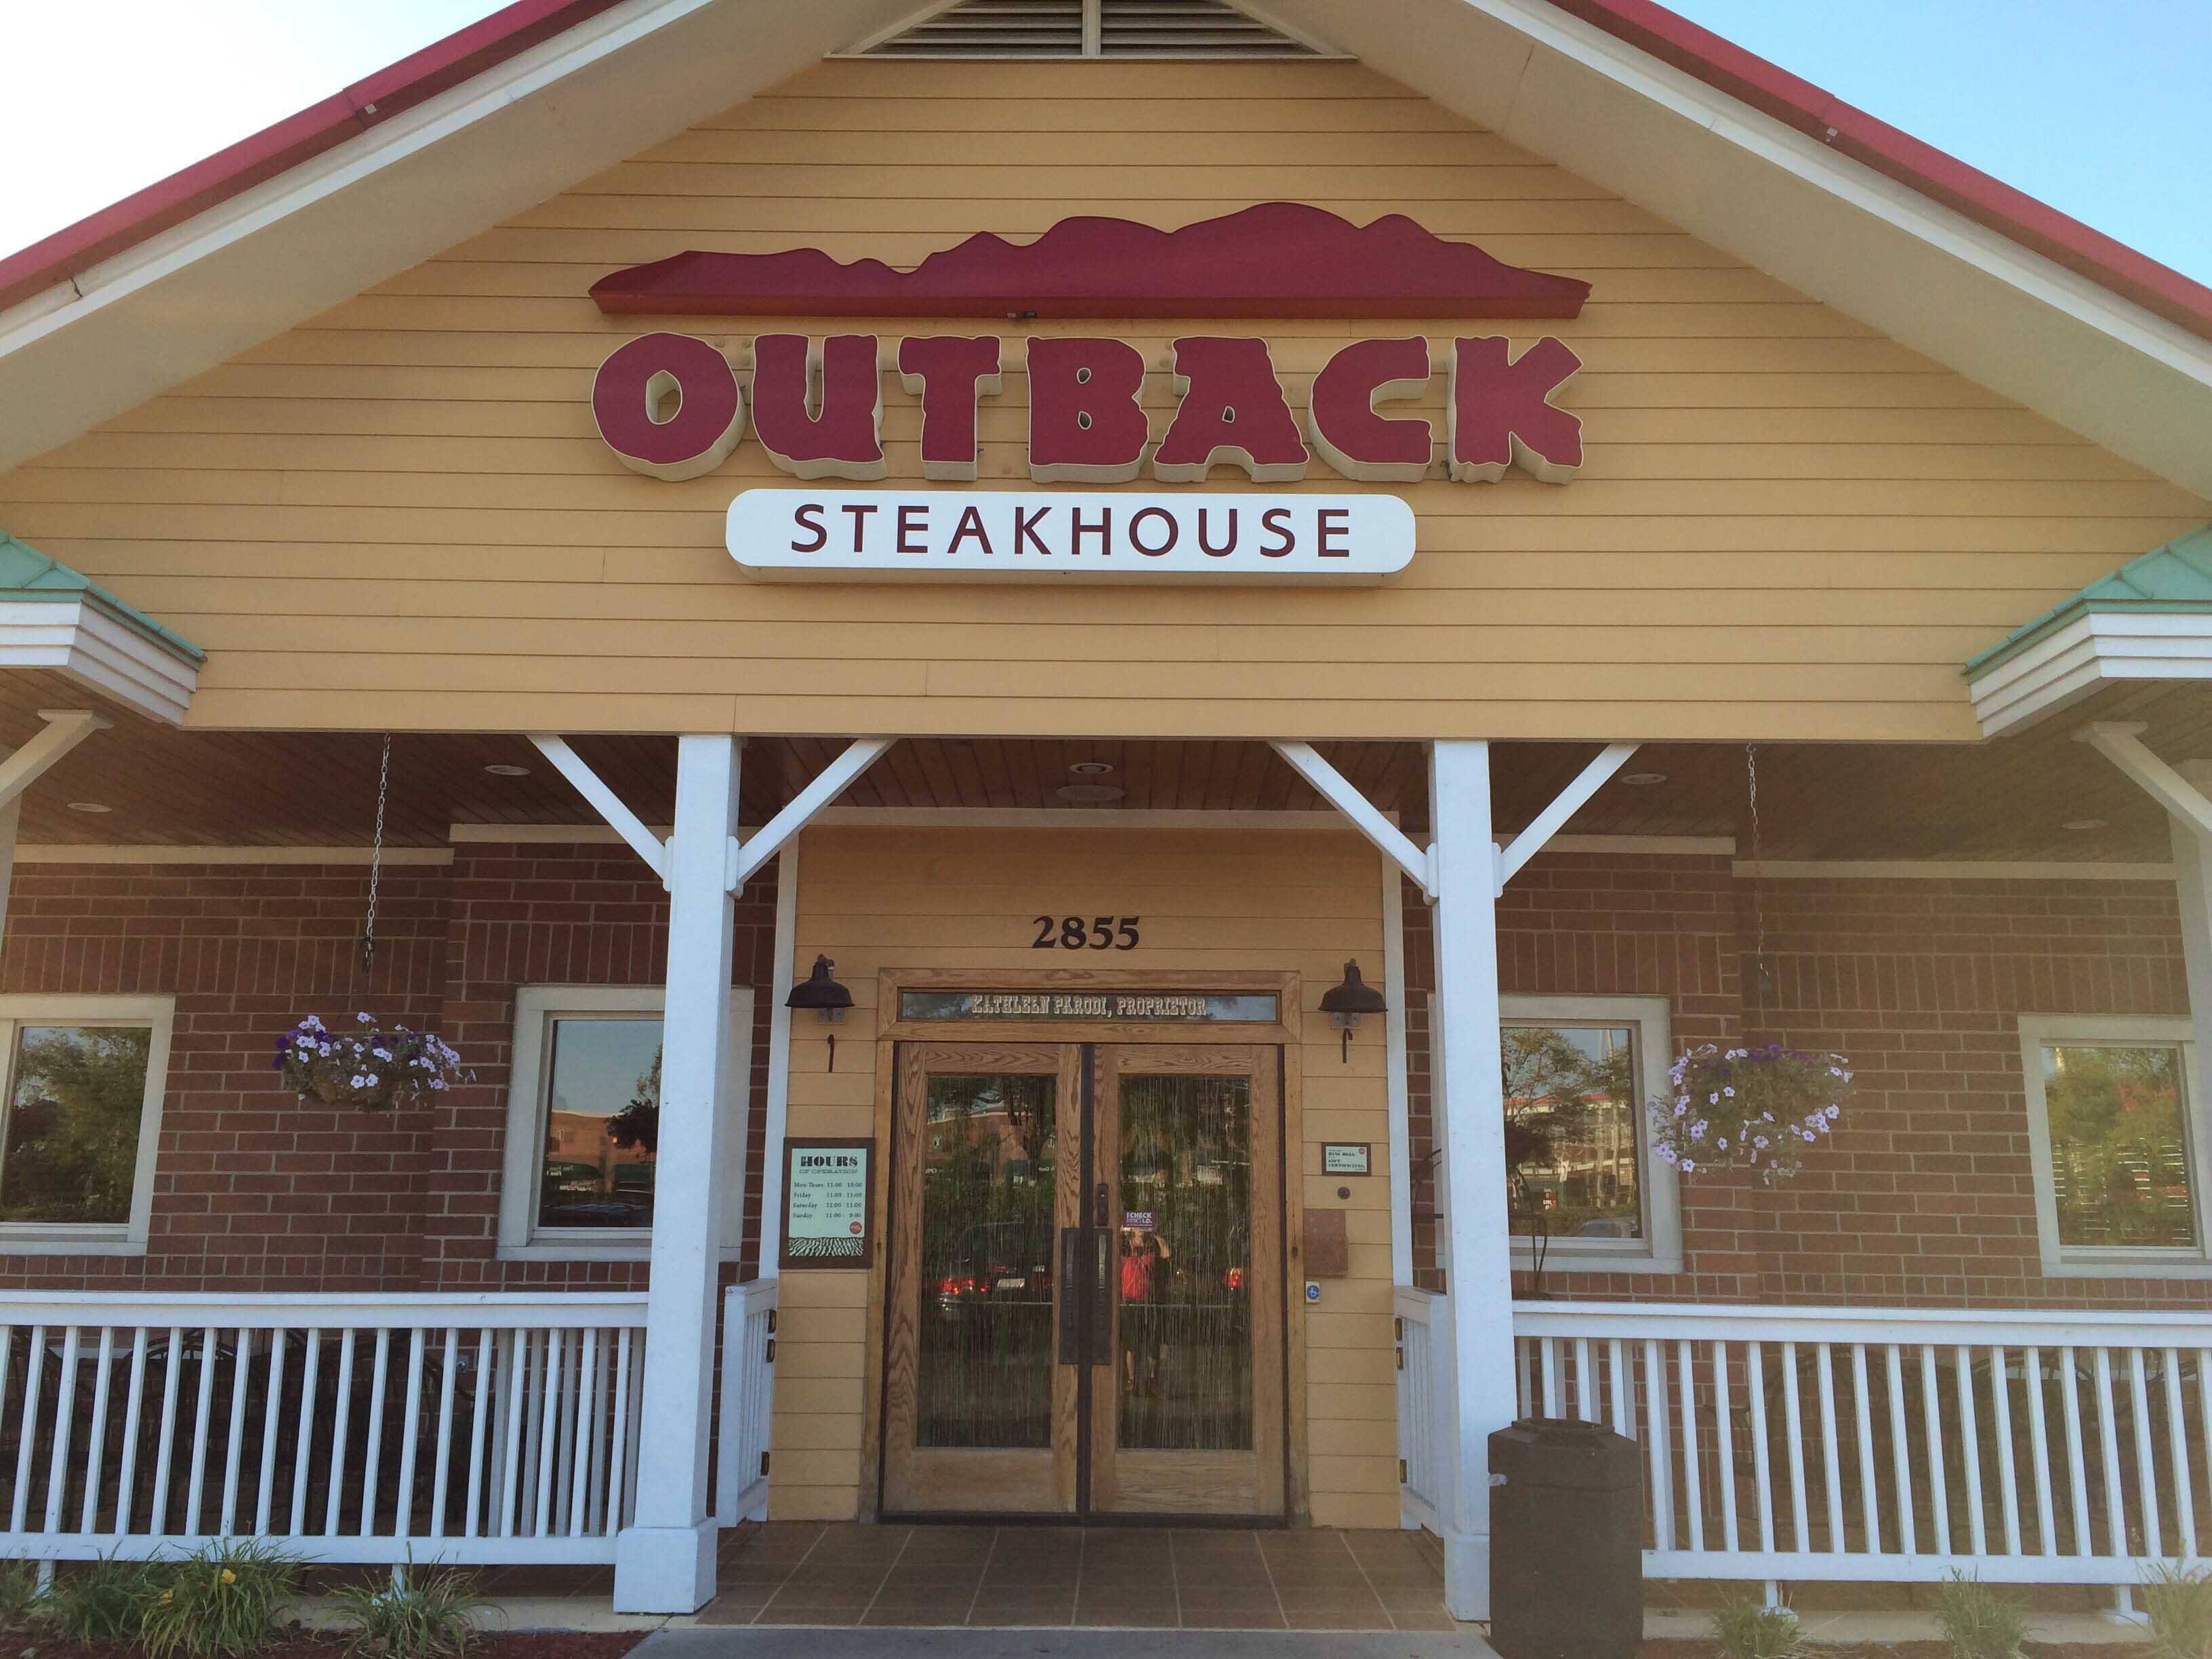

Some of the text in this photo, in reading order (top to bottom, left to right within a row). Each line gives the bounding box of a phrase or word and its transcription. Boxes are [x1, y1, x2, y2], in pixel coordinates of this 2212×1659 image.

[592, 331, 1584, 478] OUTBACK
[790, 503, 1351, 558] STEAKHOUSE
[1032, 915, 1140, 950] 2855
[972, 995, 1050, 1015] KATHLEEN
[1117, 997, 1207, 1016] PROPRIETOR
[800, 1156, 858, 1166] HOURS
